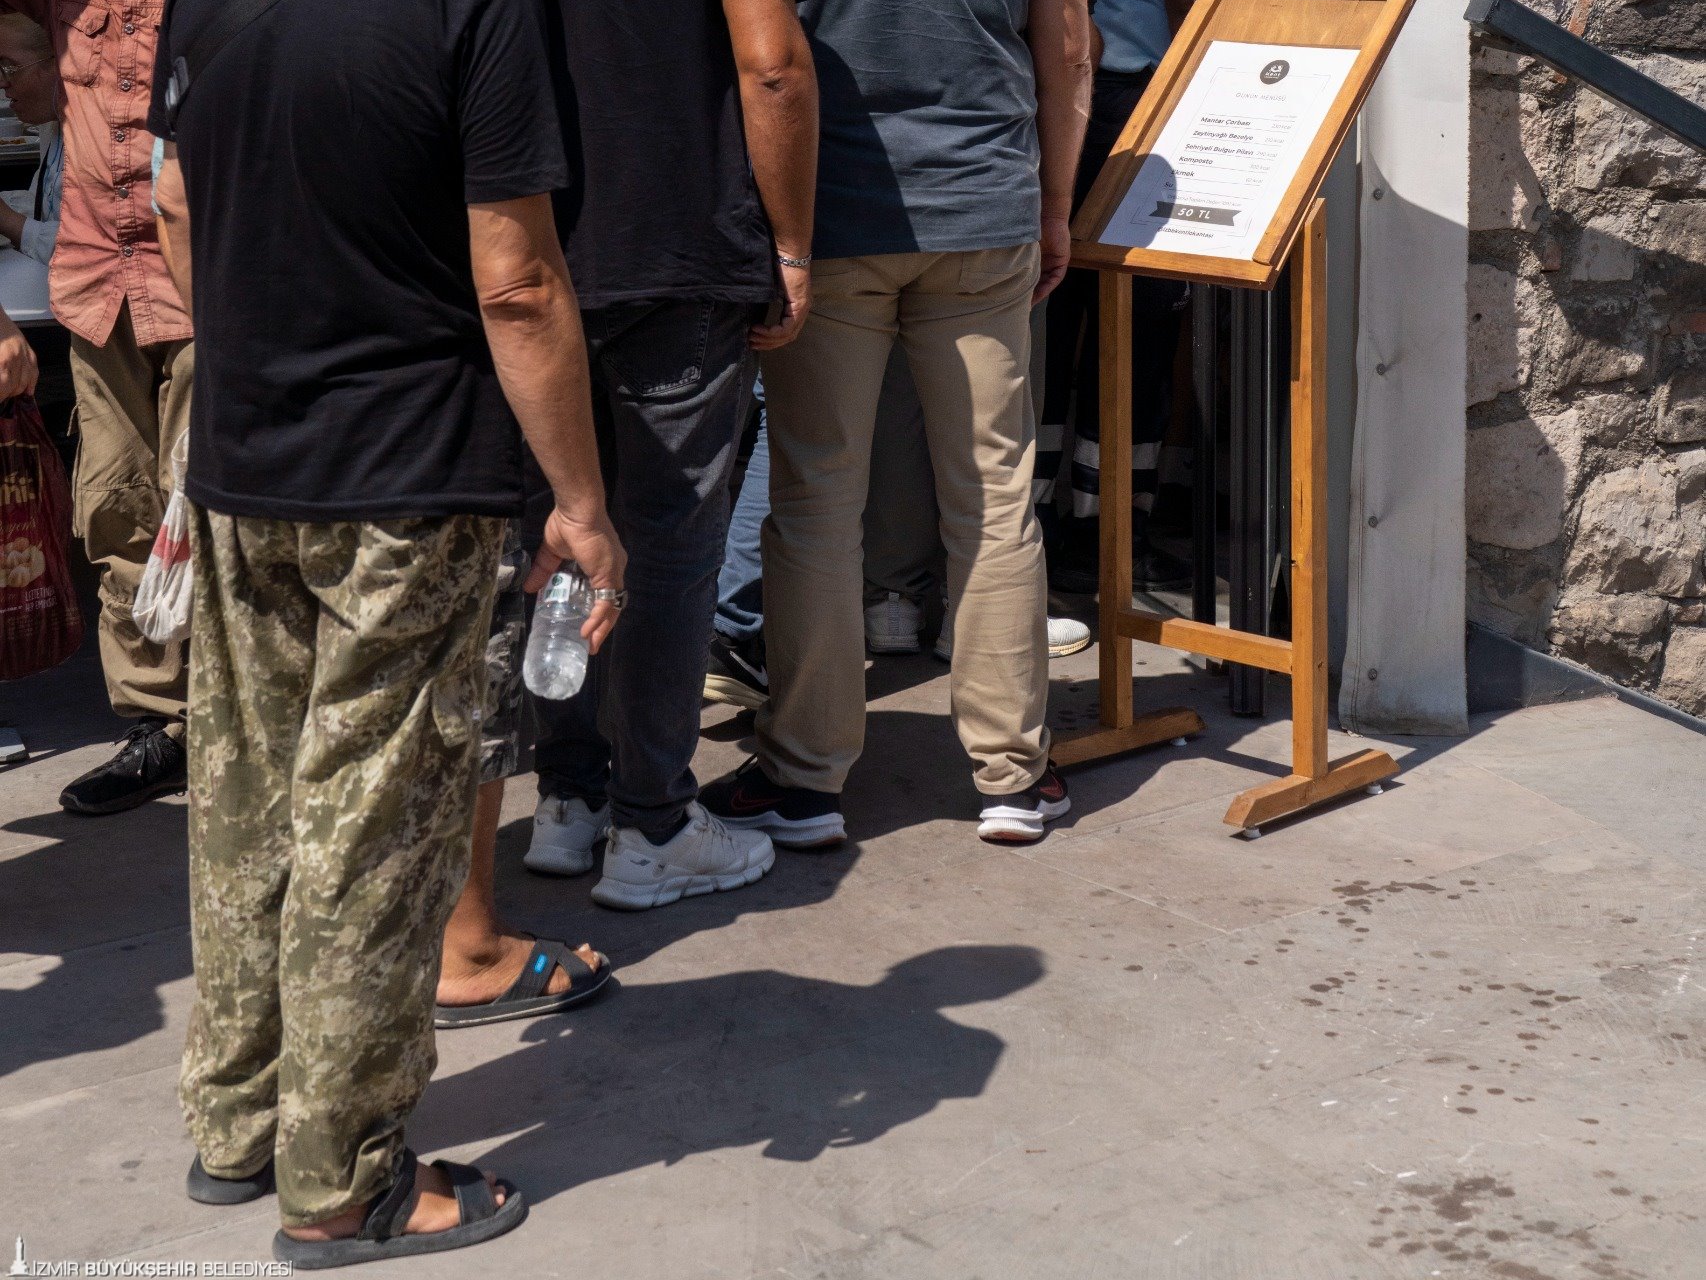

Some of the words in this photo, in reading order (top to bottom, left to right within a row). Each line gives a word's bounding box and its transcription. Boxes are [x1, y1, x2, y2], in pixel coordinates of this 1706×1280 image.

[1179, 156, 1213, 165] Komposto
[1177, 208, 1194, 217] 50
[1198, 210, 1211, 219] TL
